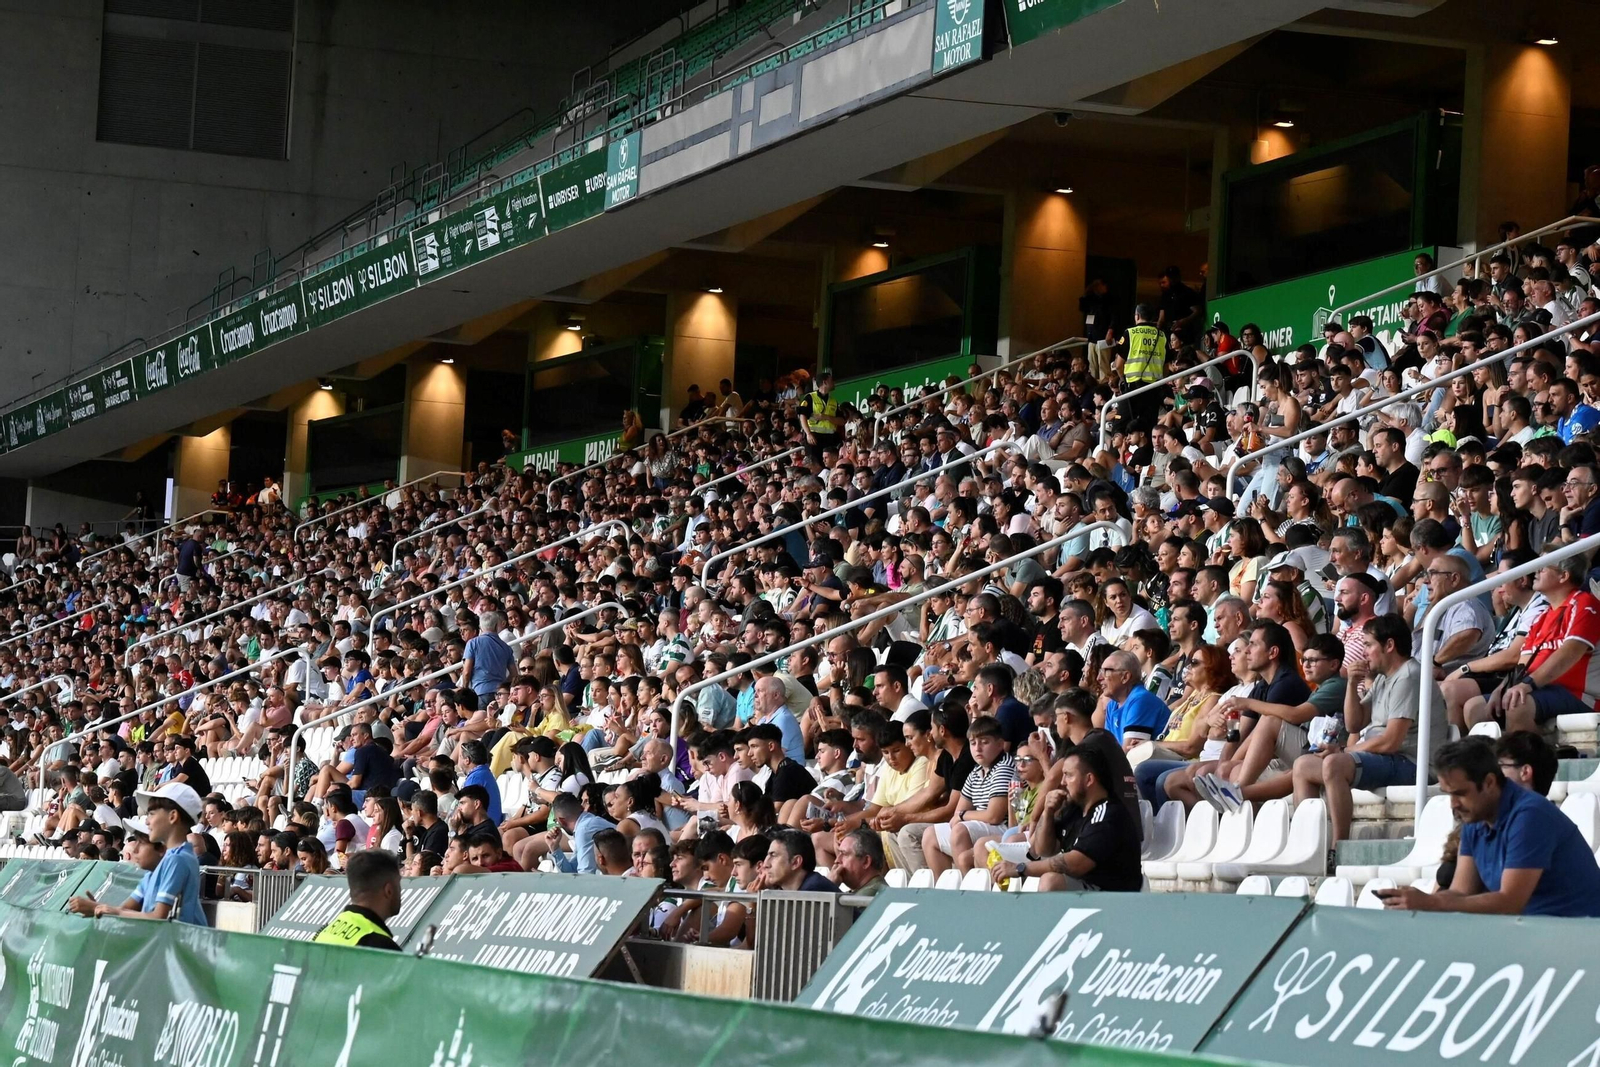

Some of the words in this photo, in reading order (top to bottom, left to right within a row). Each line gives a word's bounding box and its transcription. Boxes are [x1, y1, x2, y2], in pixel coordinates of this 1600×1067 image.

[935, 31, 951, 53] SAN
[952, 18, 982, 46] RAFAEL
[943, 42, 972, 69] MOTOR
[552, 184, 579, 207] URBYSER
[590, 171, 607, 192] URBY
[606, 172, 617, 190] SAN
[618, 165, 637, 184] RAFAEL
[611, 185, 630, 203] MOTOR
[318, 274, 355, 310] SILBON
[367, 251, 408, 289] SILBON
[220, 321, 255, 354] Cruzcampo
[260, 302, 297, 336] Cruzcampo
[279, 884, 351, 926] BAHRAI
[492, 892, 608, 944] PATRIMONIO
[600, 900, 623, 922] DE
[581, 925, 605, 946] LA
[893, 937, 1003, 989] Diputación
[1078, 948, 1223, 1007] Diputación
[862, 992, 888, 1018] de
[886, 994, 960, 1028] Córdoba
[1294, 953, 1586, 1065] SILBON
[1075, 1012, 1174, 1053] Córdoba
